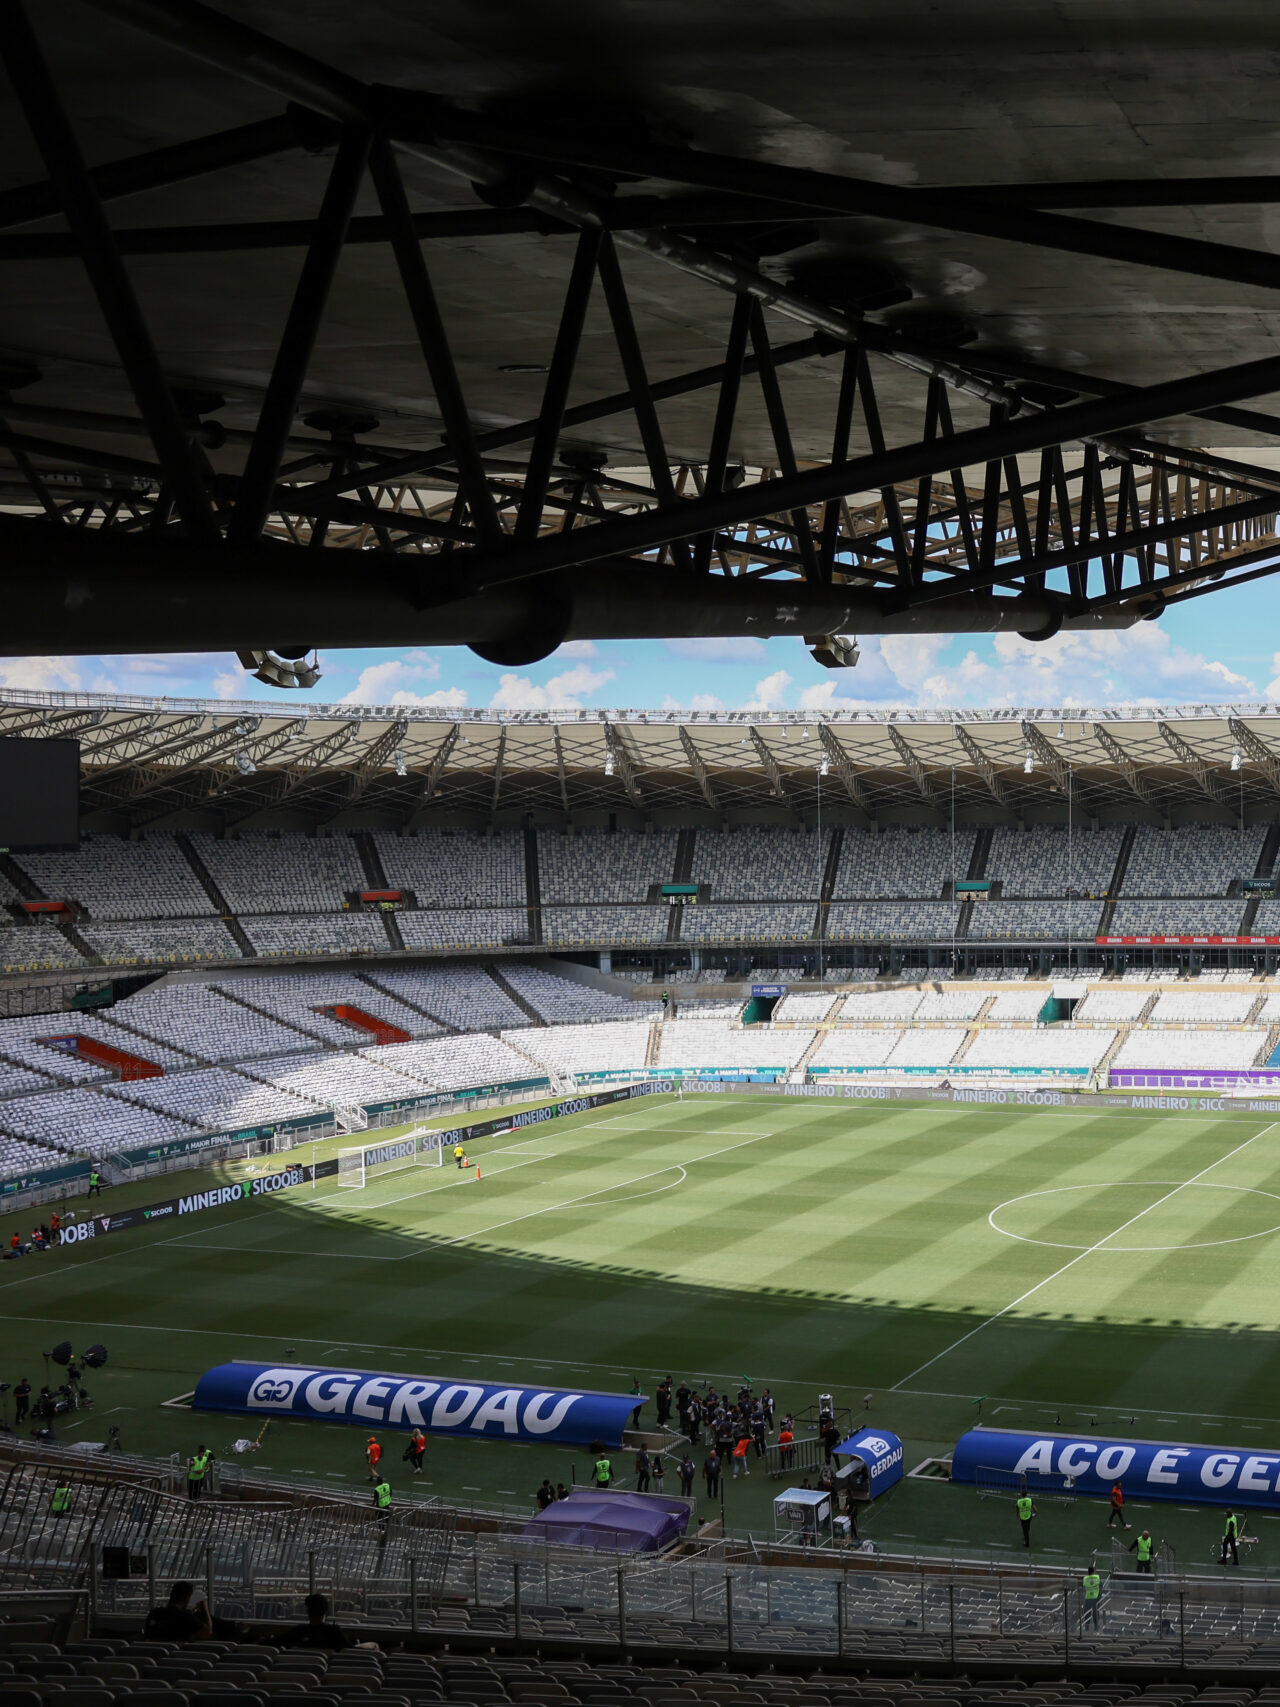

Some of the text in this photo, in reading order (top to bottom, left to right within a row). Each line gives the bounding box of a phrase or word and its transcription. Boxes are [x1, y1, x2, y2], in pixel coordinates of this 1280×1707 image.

[630, 1081, 672, 1098] MINEIRO
[682, 1080, 720, 1093] SICOOB
[784, 1084, 886, 1098] MINEIRO SICOOB
[953, 1089, 1006, 1103] MINEIRO
[1016, 1092, 1060, 1105] SICOOB
[512, 1098, 587, 1127] MINEIRO SICOOB
[1132, 1096, 1189, 1109] MINEIRO
[211, 1135, 231, 1145] FINAL
[365, 1129, 459, 1166] MINEIRO SICOOB
[178, 1170, 299, 1215] MINEIRO SICOOB
[151, 1206, 173, 1217] SICOOB
[305, 1373, 584, 1434] GERDAU
[870, 1446, 903, 1479] GERDAU
[1013, 1440, 1136, 1488] AÇO
[1146, 1447, 1191, 1484] É
